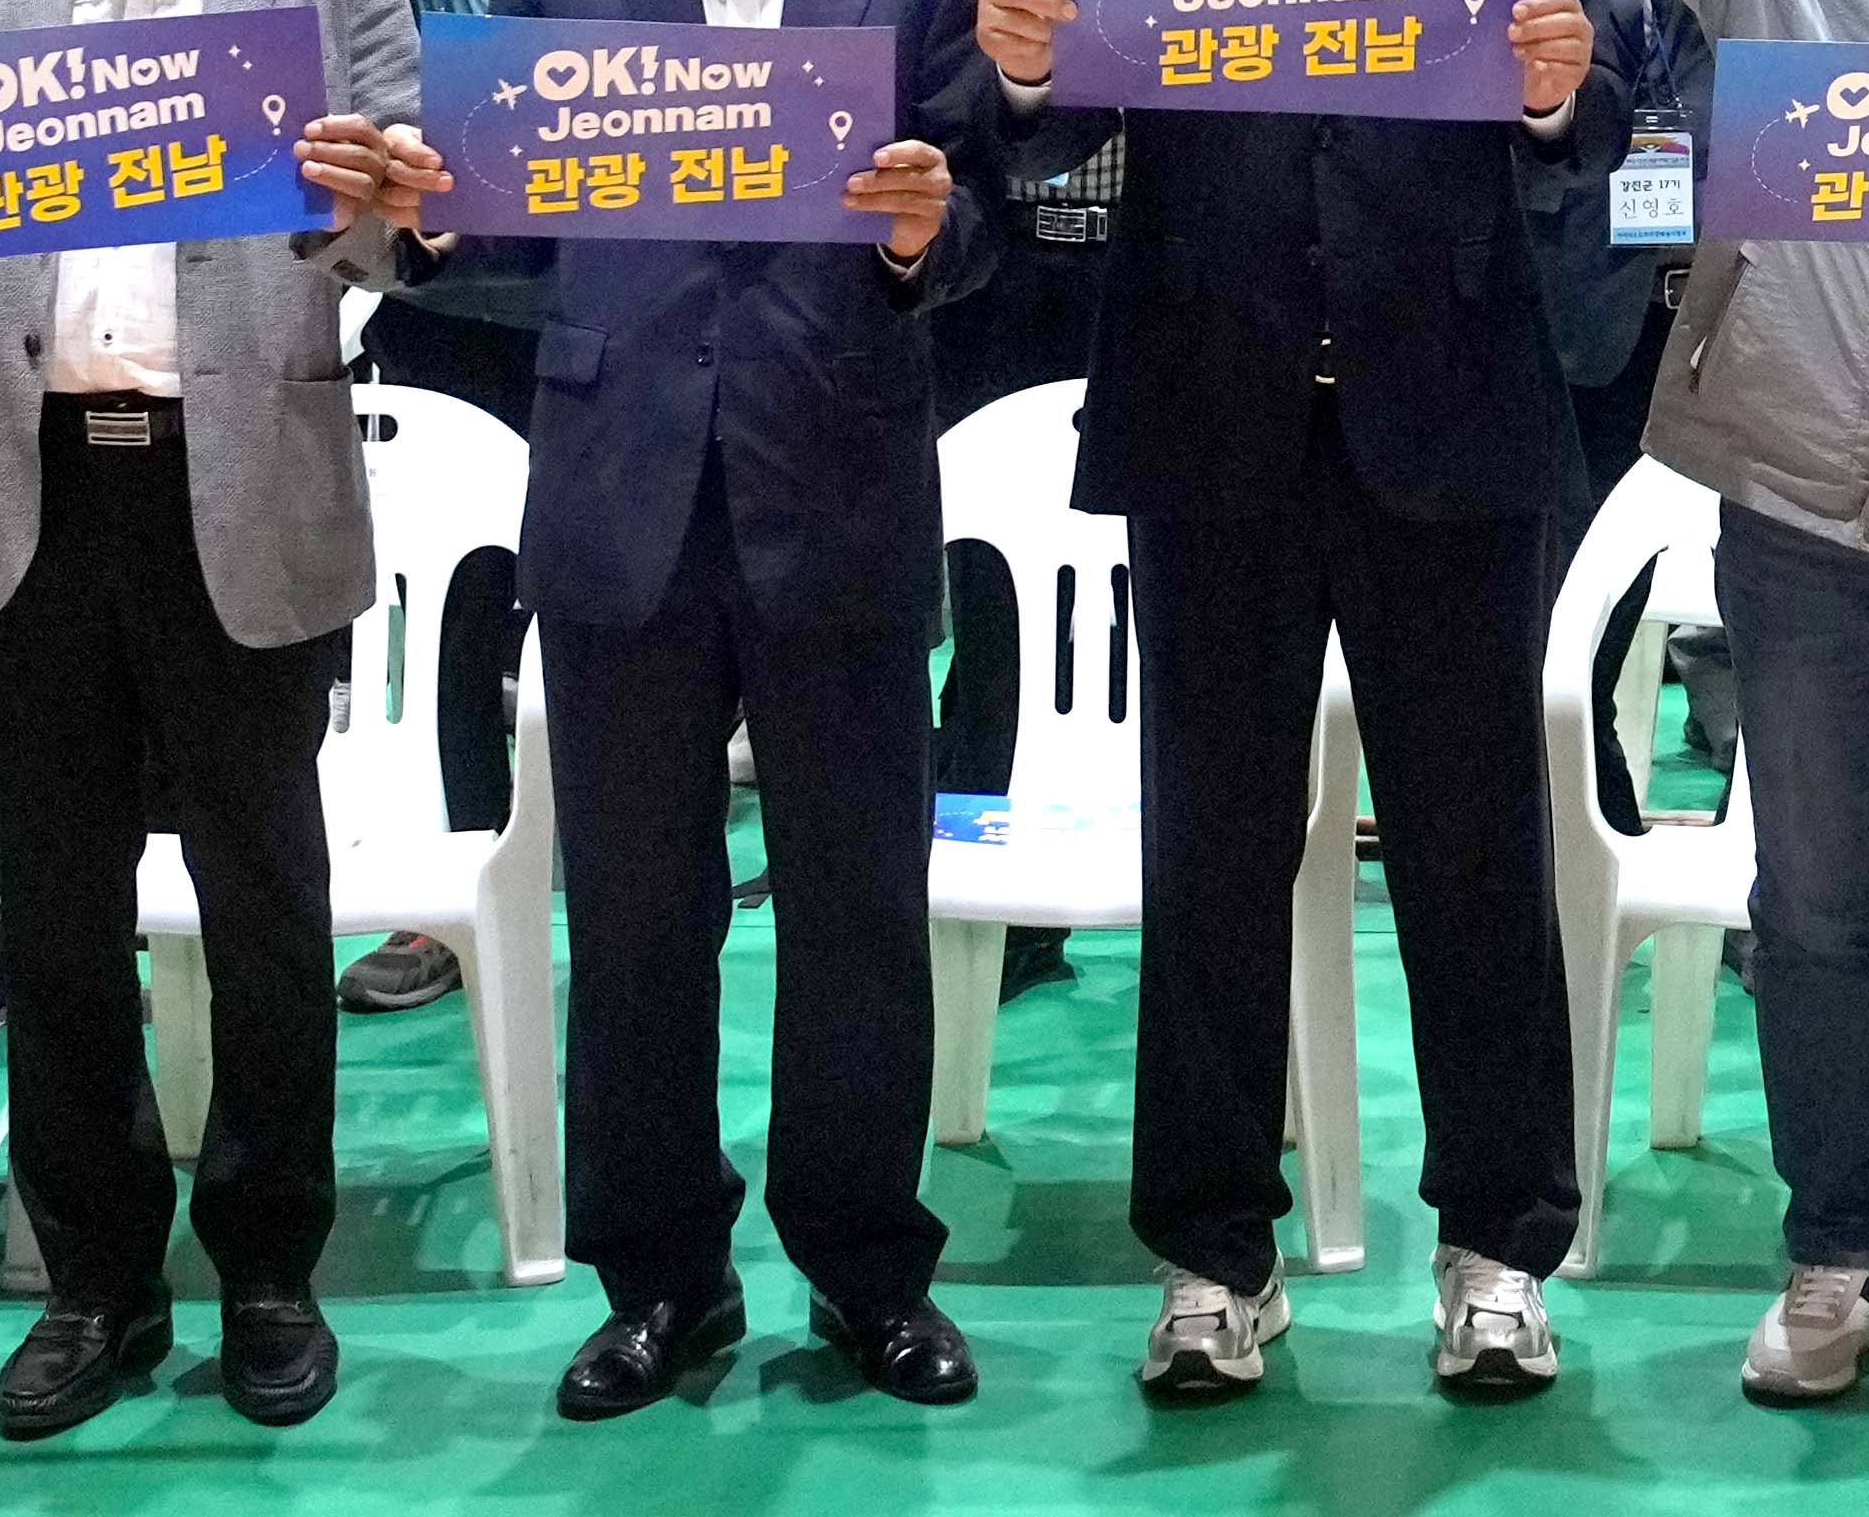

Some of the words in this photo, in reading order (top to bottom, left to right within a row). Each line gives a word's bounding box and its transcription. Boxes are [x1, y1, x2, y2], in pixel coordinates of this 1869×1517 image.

[91, 50, 199, 93] Now
[534, 46, 659, 100] OK!
[665, 58, 772, 92] Now
[1159, 24, 1279, 85] 관광
[1303, 16, 1422, 75] 전남
[538, 103, 771, 141] Jeonnam
[108, 135, 226, 208] 전남
[525, 153, 645, 213] 관광
[670, 144, 789, 203] 전남
[1659, 179, 1681, 189] 17기
